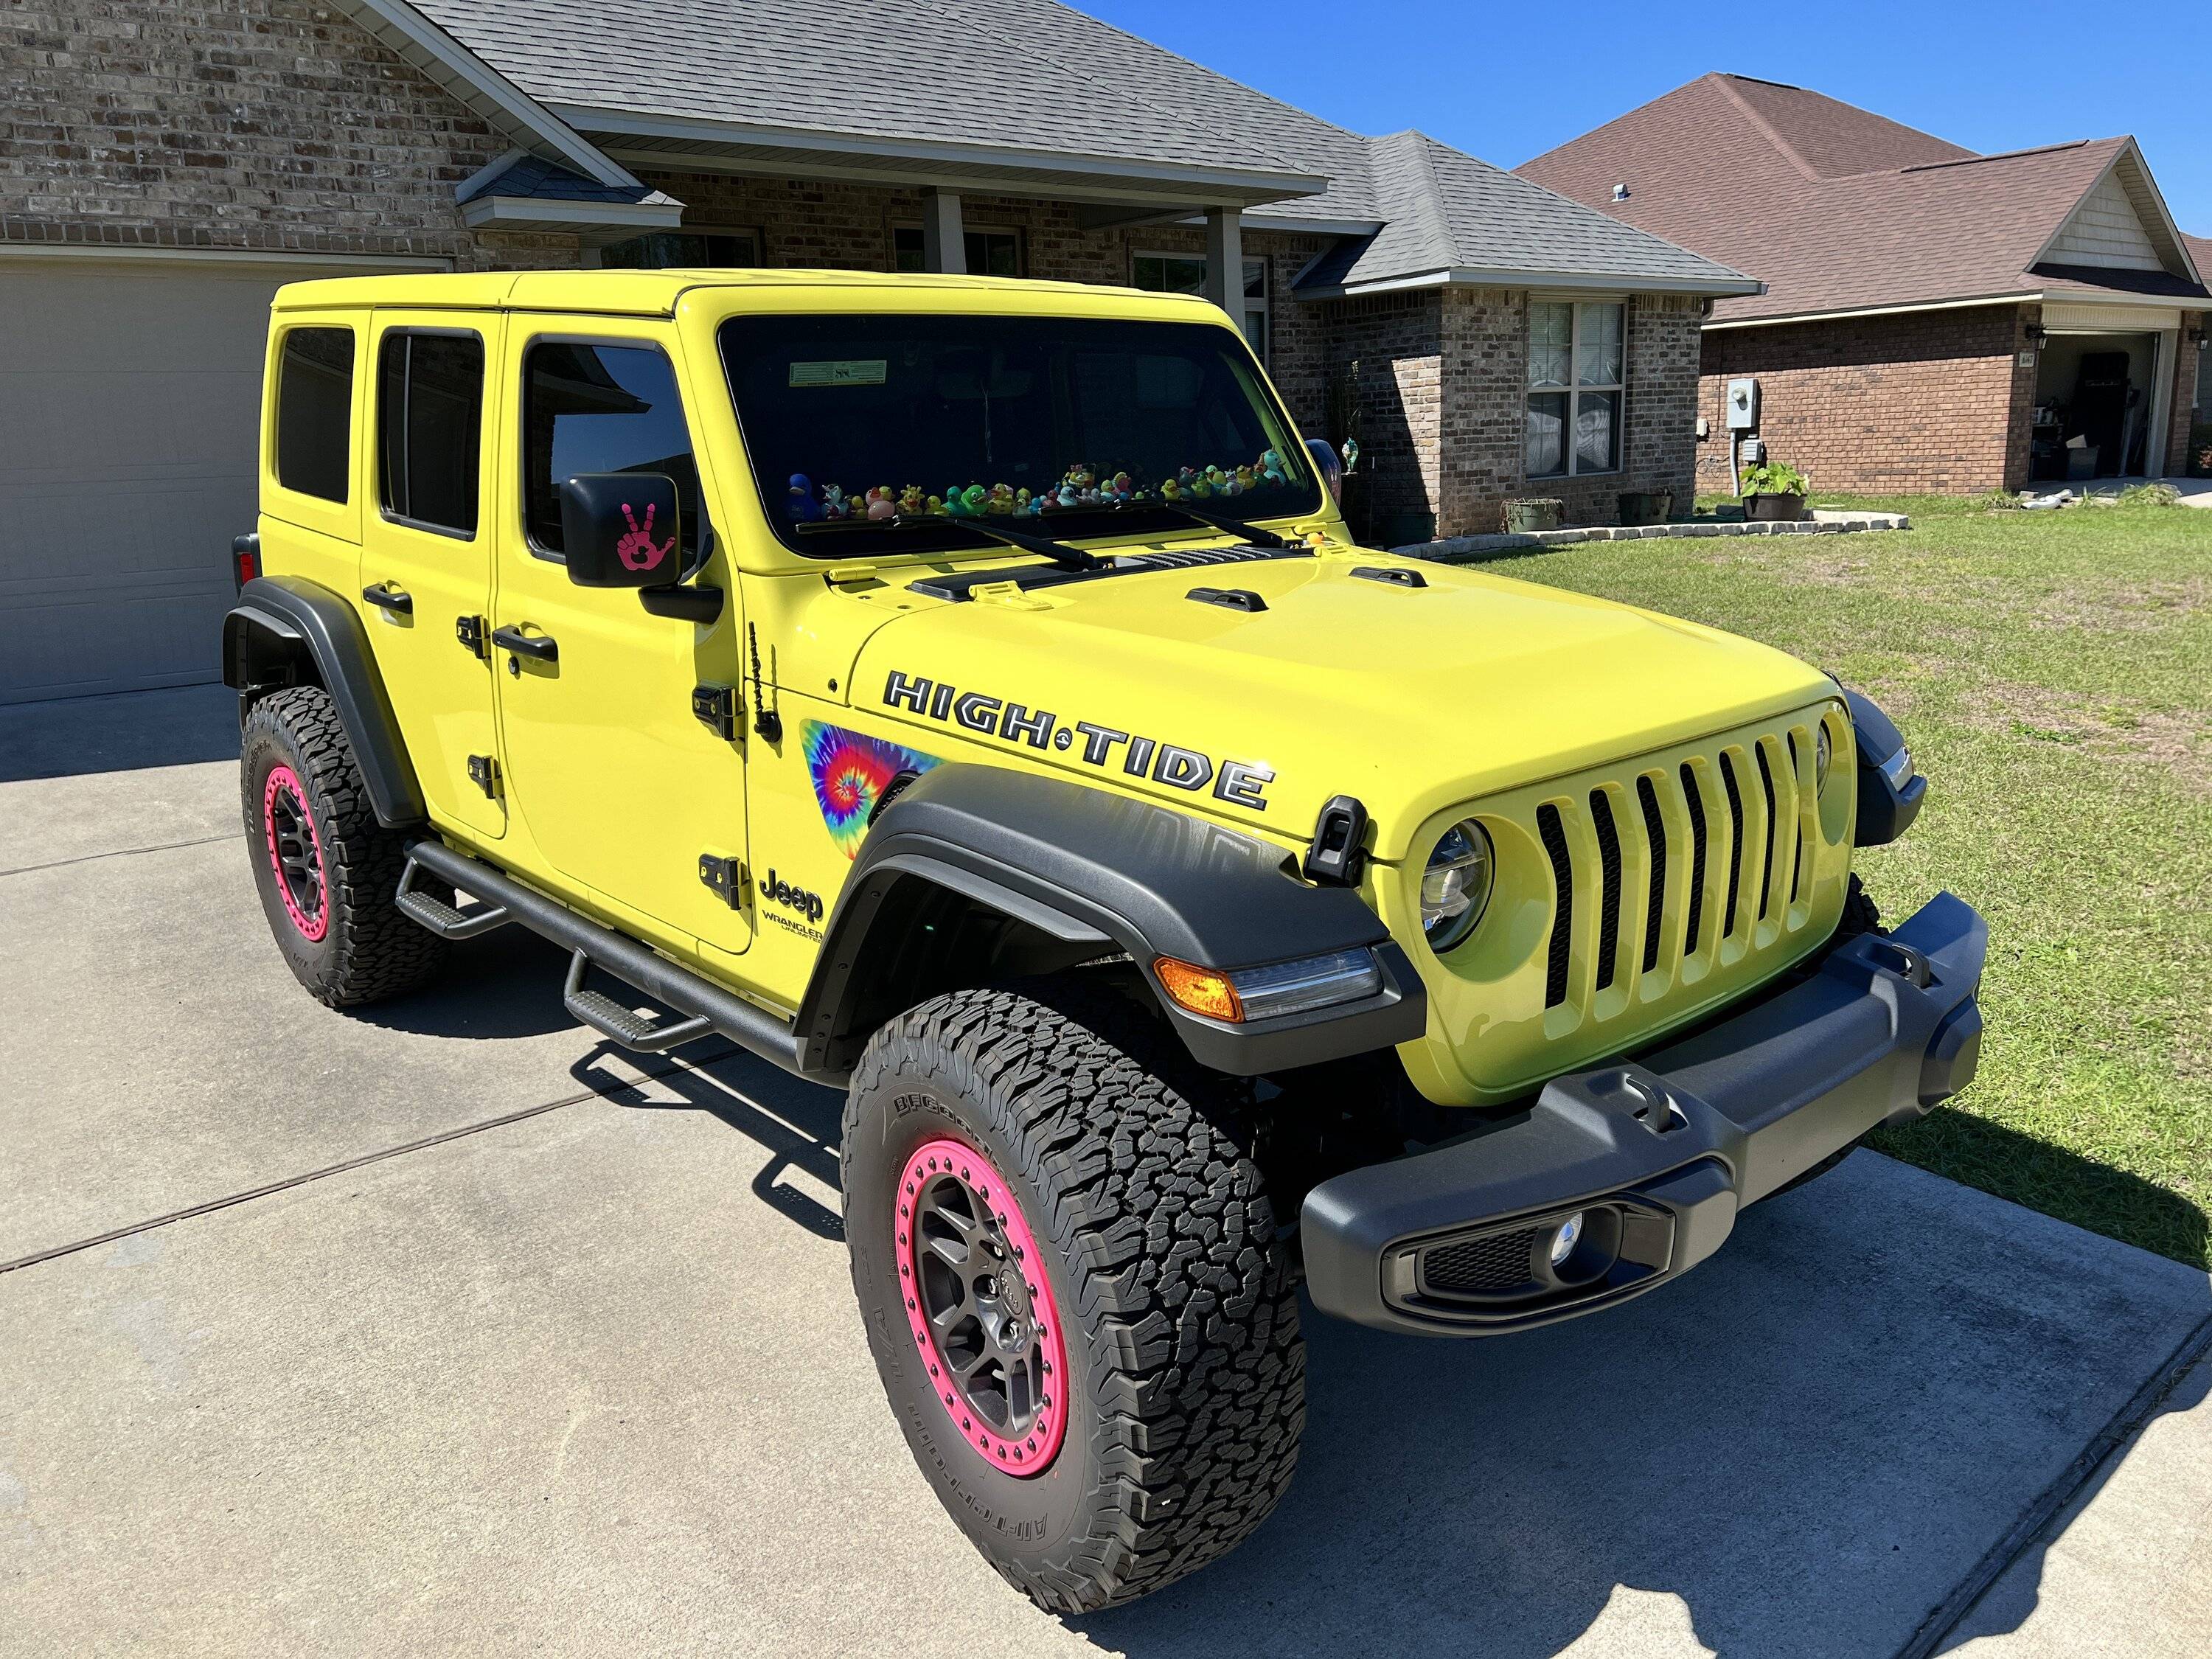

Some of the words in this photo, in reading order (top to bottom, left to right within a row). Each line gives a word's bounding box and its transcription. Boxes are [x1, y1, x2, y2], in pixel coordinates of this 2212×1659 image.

[883, 670, 1056, 750] HIGH
[1077, 721, 1276, 811] TIDE
[759, 868, 823, 923] Jeep
[762, 909, 823, 940] WRANGLER
[782, 925, 822, 944] UNLIMITED
